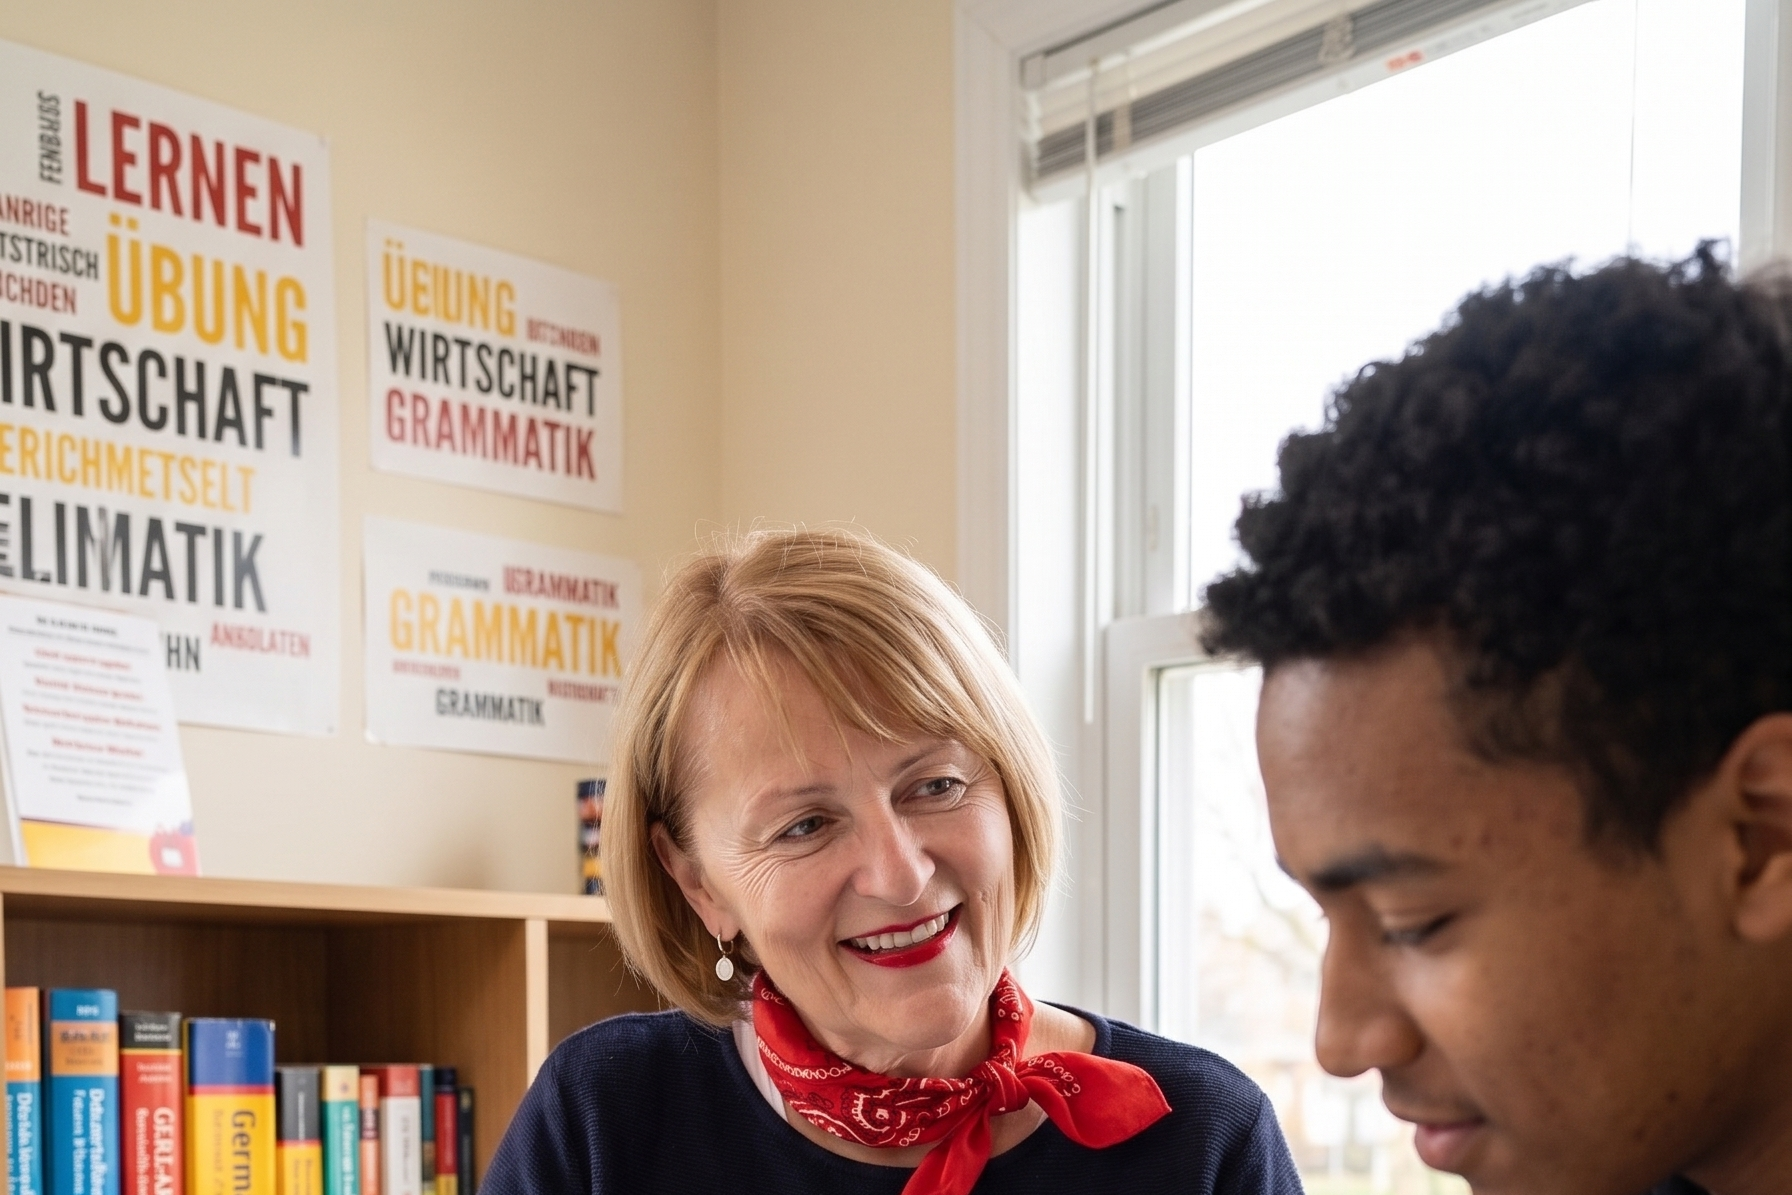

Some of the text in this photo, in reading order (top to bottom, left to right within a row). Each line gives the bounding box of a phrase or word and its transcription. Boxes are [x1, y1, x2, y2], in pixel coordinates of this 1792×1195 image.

[75, 100, 303, 247] LERNEN
[107, 213, 307, 362] ÜBUNG
[385, 322, 600, 417] WIRTSCHAFT
[387, 389, 596, 482] GRAMMATIK
[160, 632, 201, 672] HN
[389, 587, 622, 678] GRAMMATIK
[437, 688, 545, 726] GRAMMATIK
